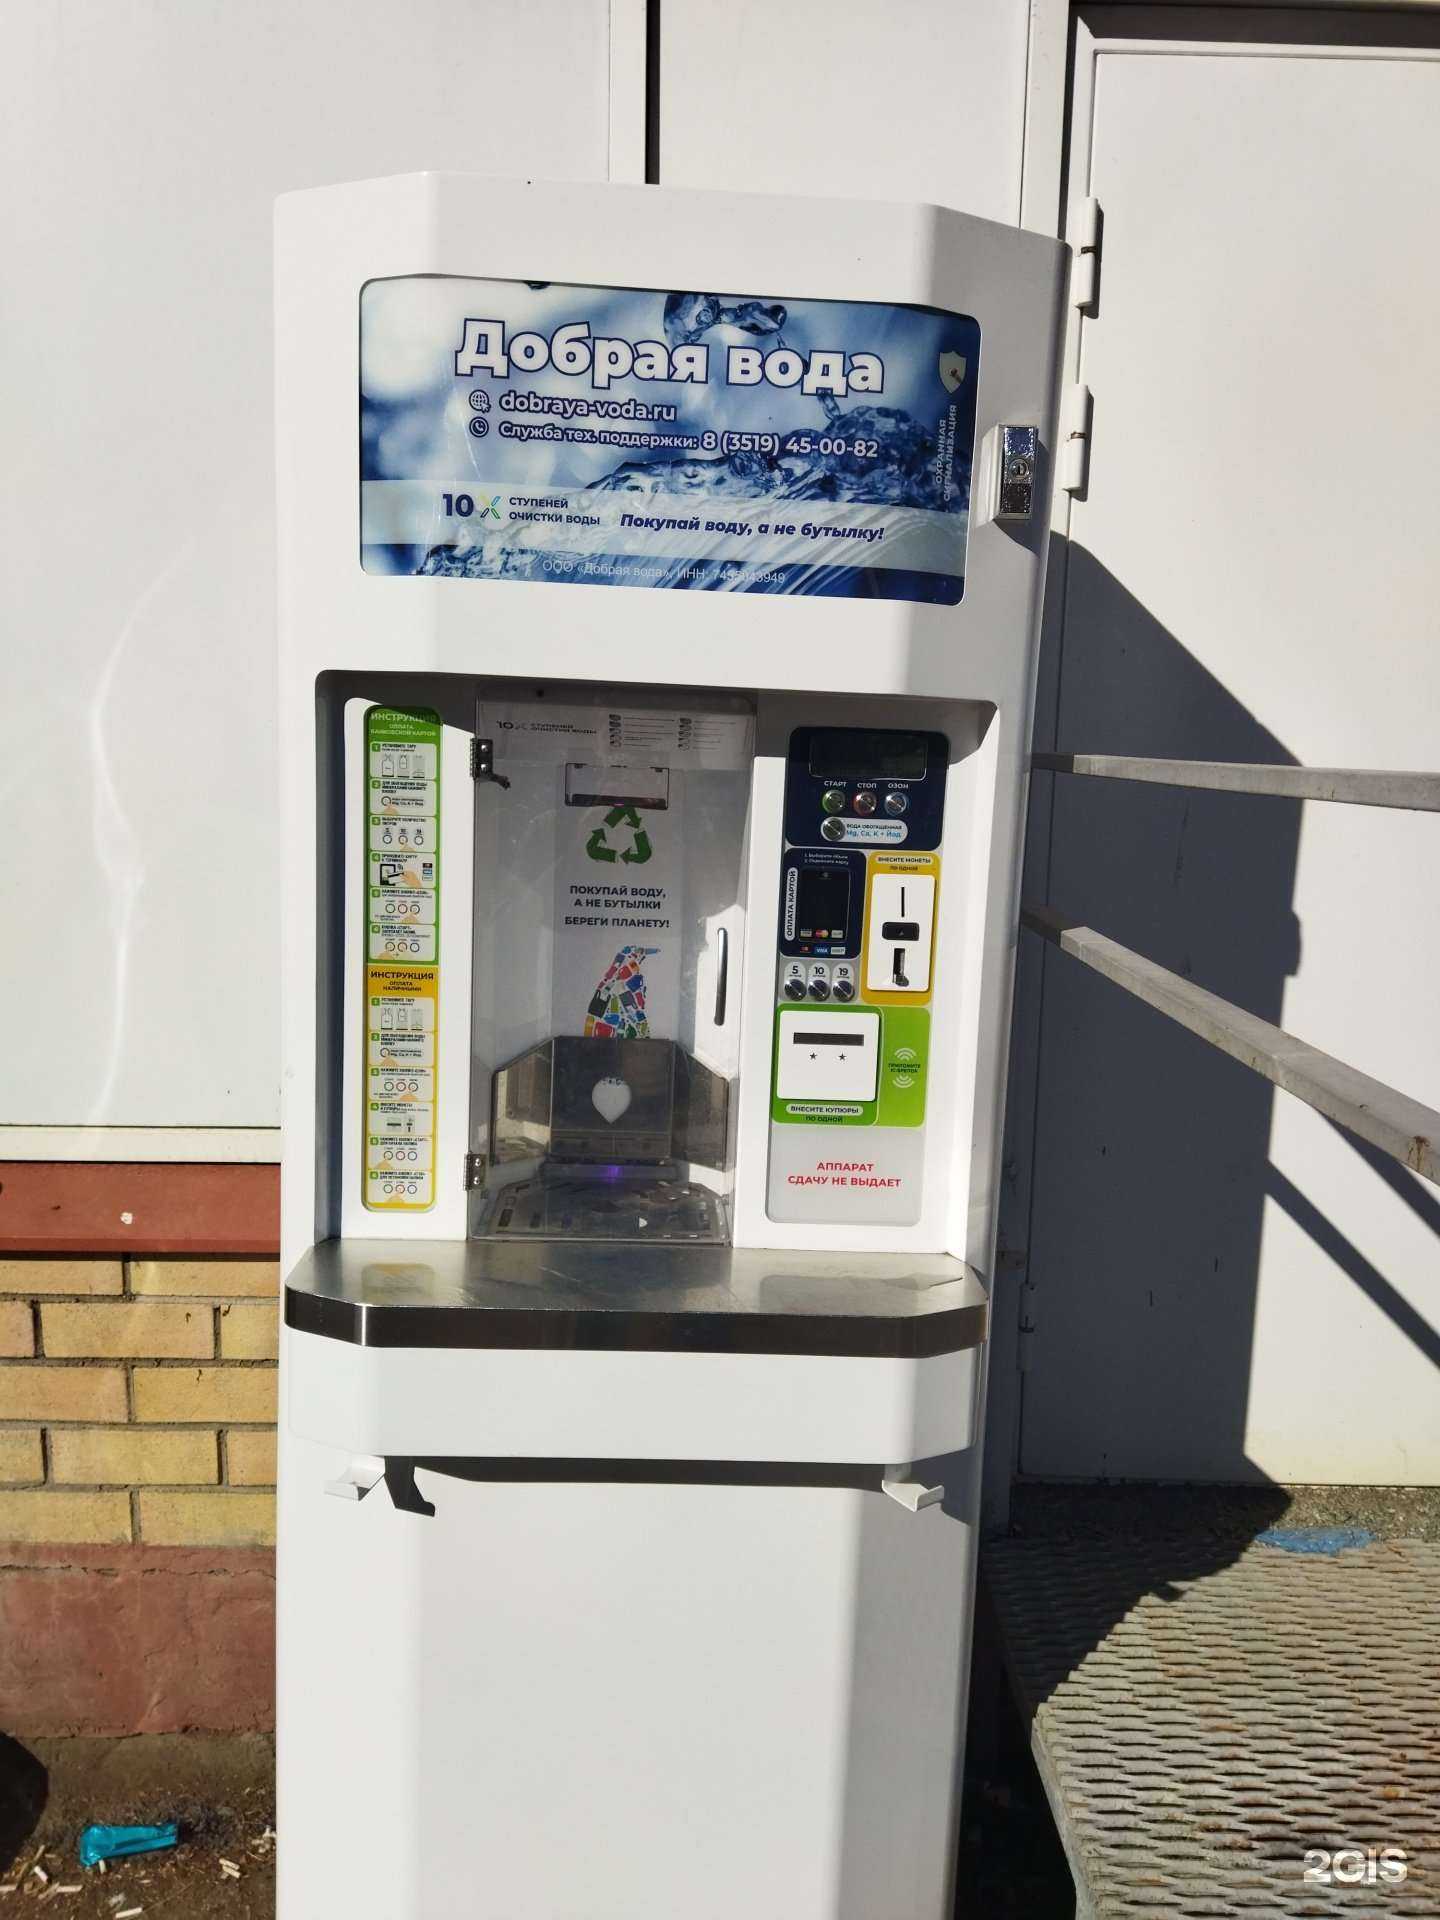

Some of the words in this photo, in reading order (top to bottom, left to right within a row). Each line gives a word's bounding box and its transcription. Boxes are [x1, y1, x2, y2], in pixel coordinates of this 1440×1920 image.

[455, 318, 709, 390] Добрая
[726, 345, 885, 398] вода
[500, 390, 677, 422] dobraya-voda.ru
[500, 421, 564, 441] Служба
[565, 428, 598, 444] тех.
[599, 431, 699, 449] поддержки:
[702, 430, 717, 450] 8
[721, 431, 779, 456] (3519)
[785, 435, 879, 459] 45-00-82
[935, 419, 947, 484] ОХРАННАЯ
[943, 404, 957, 501] СИГНАЛИЗАЦИЯ
[442, 493, 474, 518] 10
[509, 496, 569, 509] СТУПЕНЕЙ
[509, 511, 562, 523] ОЧИСТКИ
[566, 515, 600, 526] ВОДЫ
[620, 513, 700, 532] Покупай
[704, 521, 752, 536] воду,
[758, 523, 769, 534] а
[774, 523, 796, 536] не
[801, 522, 885, 543] бутылку!
[542, 560, 573, 573] ООО
[577, 562, 630, 576] «Добрая
[570, 885, 627, 896] ПОКУПАЙ
[631, 887, 666, 898] ВОДУ,
[788, 870, 796, 903] КАРТОЙ
[574, 899, 582, 907] А
[586, 899, 601, 908] НЕ
[604, 900, 661, 910] БУТЫЛКИ
[565, 916, 609, 926] БЕРЕГИ
[612, 918, 670, 928] ПЛАНЕТУ!
[371, 971, 434, 980] ИНСТРУКЦИЯ
[791, 965, 799, 974] 5
[814, 966, 825, 975] 10
[839, 967, 849, 976] 19
[818, 1115, 843, 1123] ОДНОЙ
[817, 1162, 874, 1172] АППАРАТ
[788, 1175, 828, 1185] СДАЧУ
[832, 1177, 847, 1186] НЕ
[851, 1178, 902, 1188] ВЫДАЕТ
